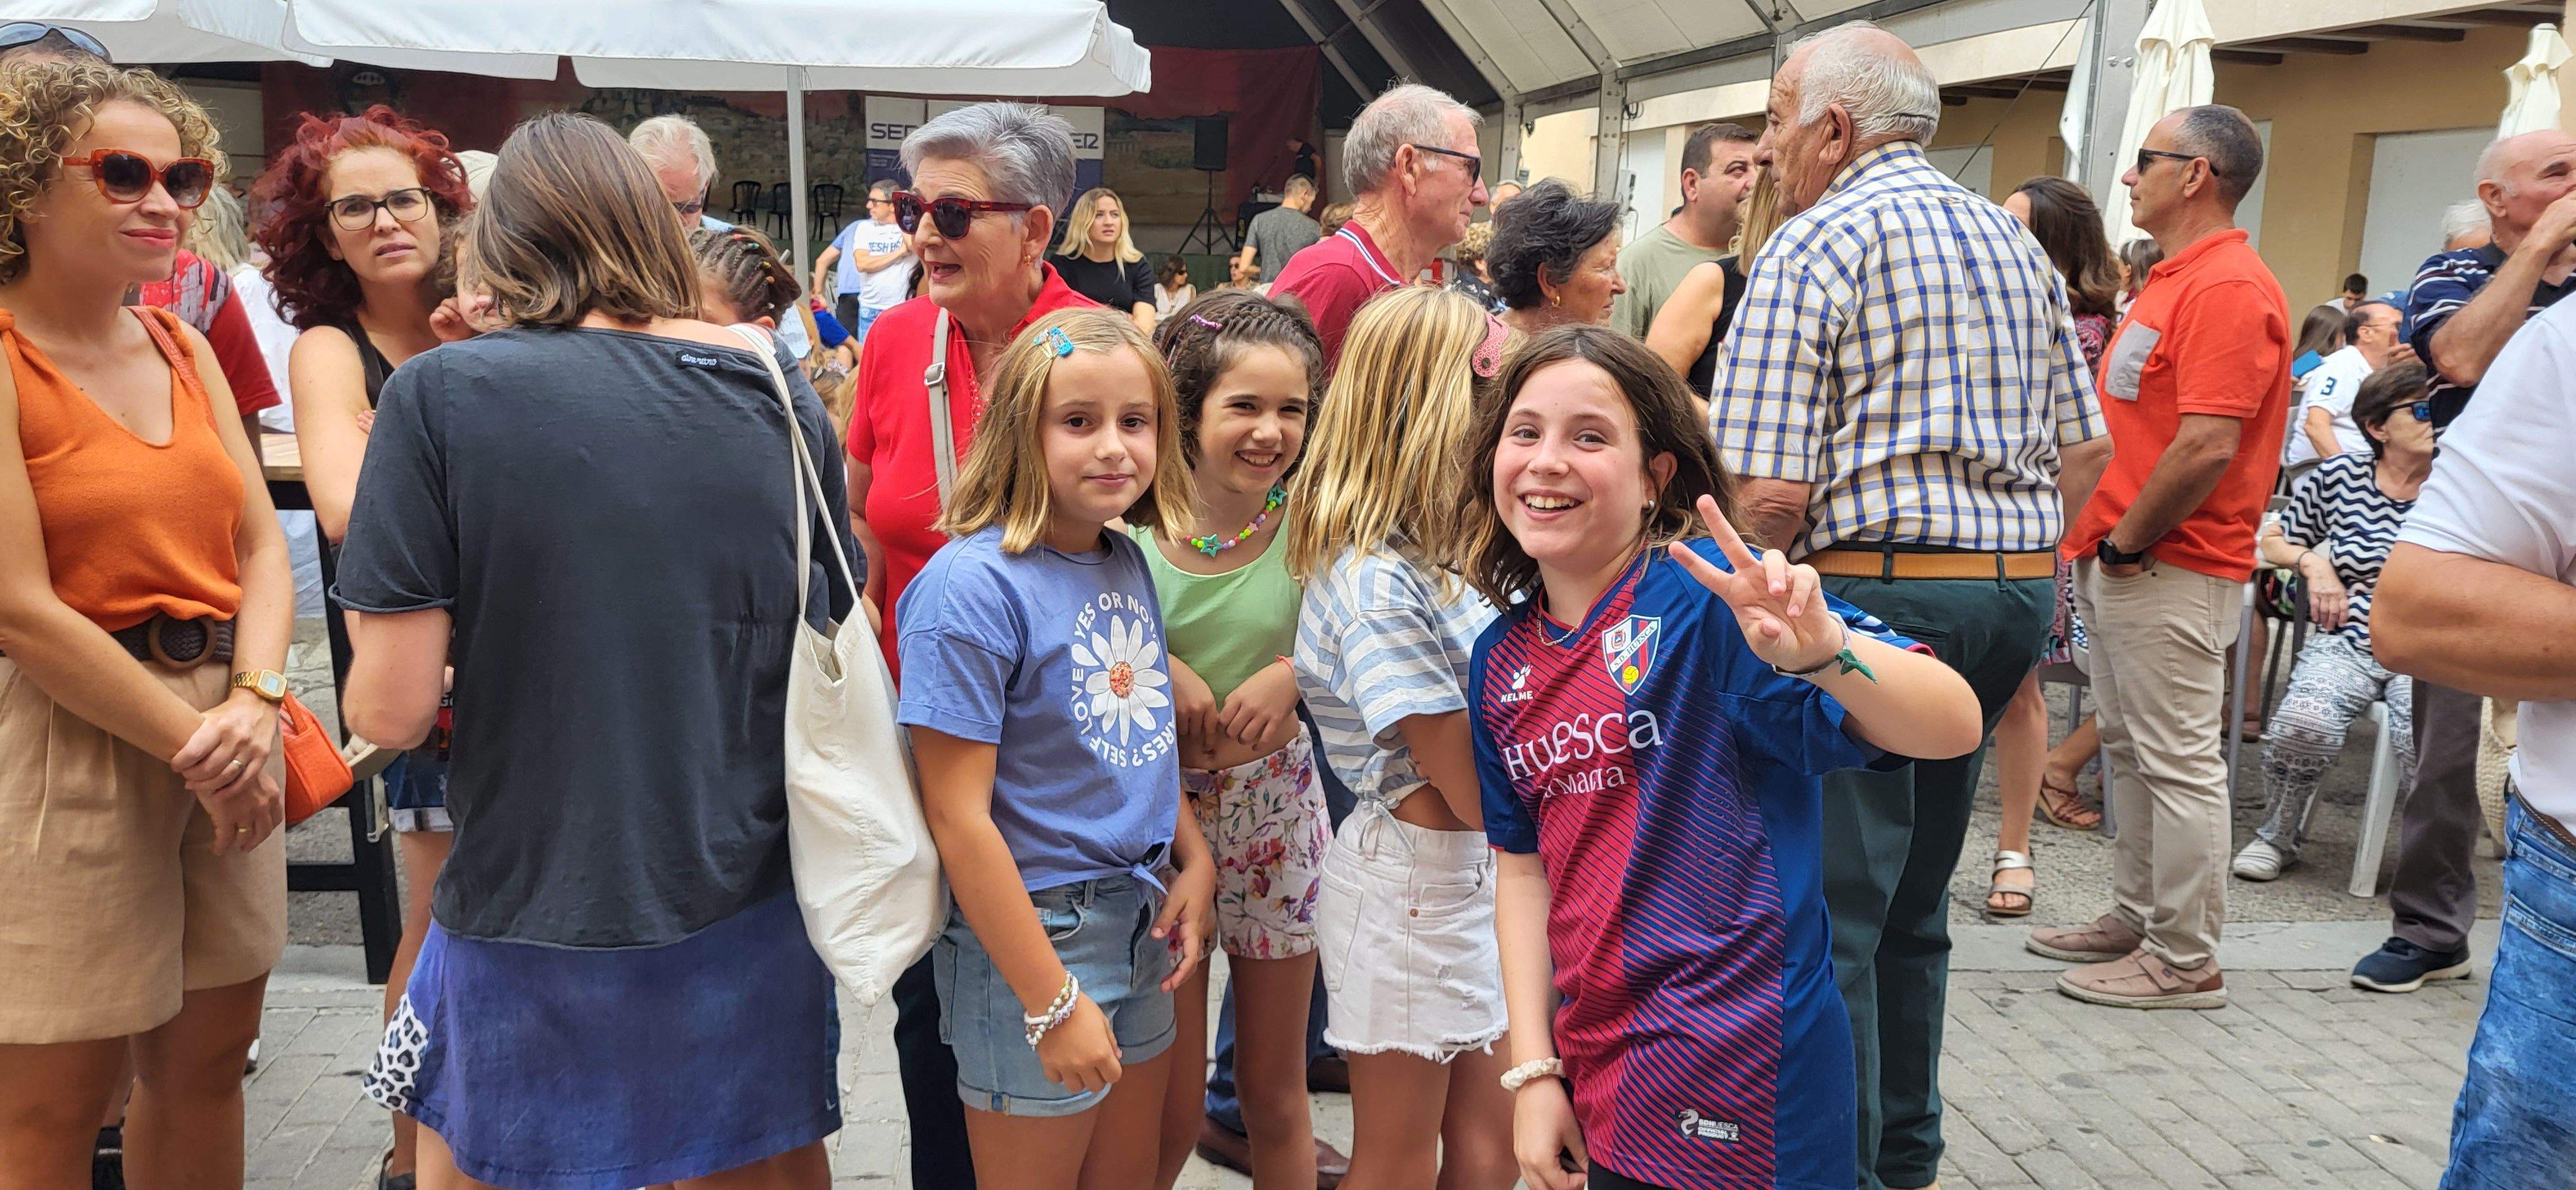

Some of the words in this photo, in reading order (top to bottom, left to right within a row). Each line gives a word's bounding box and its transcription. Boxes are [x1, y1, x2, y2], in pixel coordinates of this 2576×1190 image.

[1069, 133, 1099, 149] ER
[2320, 376, 2337, 396] 3
[1099, 592, 1124, 610] OR
[1074, 602, 1096, 639] YES
[1626, 625, 1655, 656] HUESCA
[1071, 667, 1093, 735] LOVE
[1501, 690, 1533, 703] KELME
[1089, 736, 1128, 768] SELF
